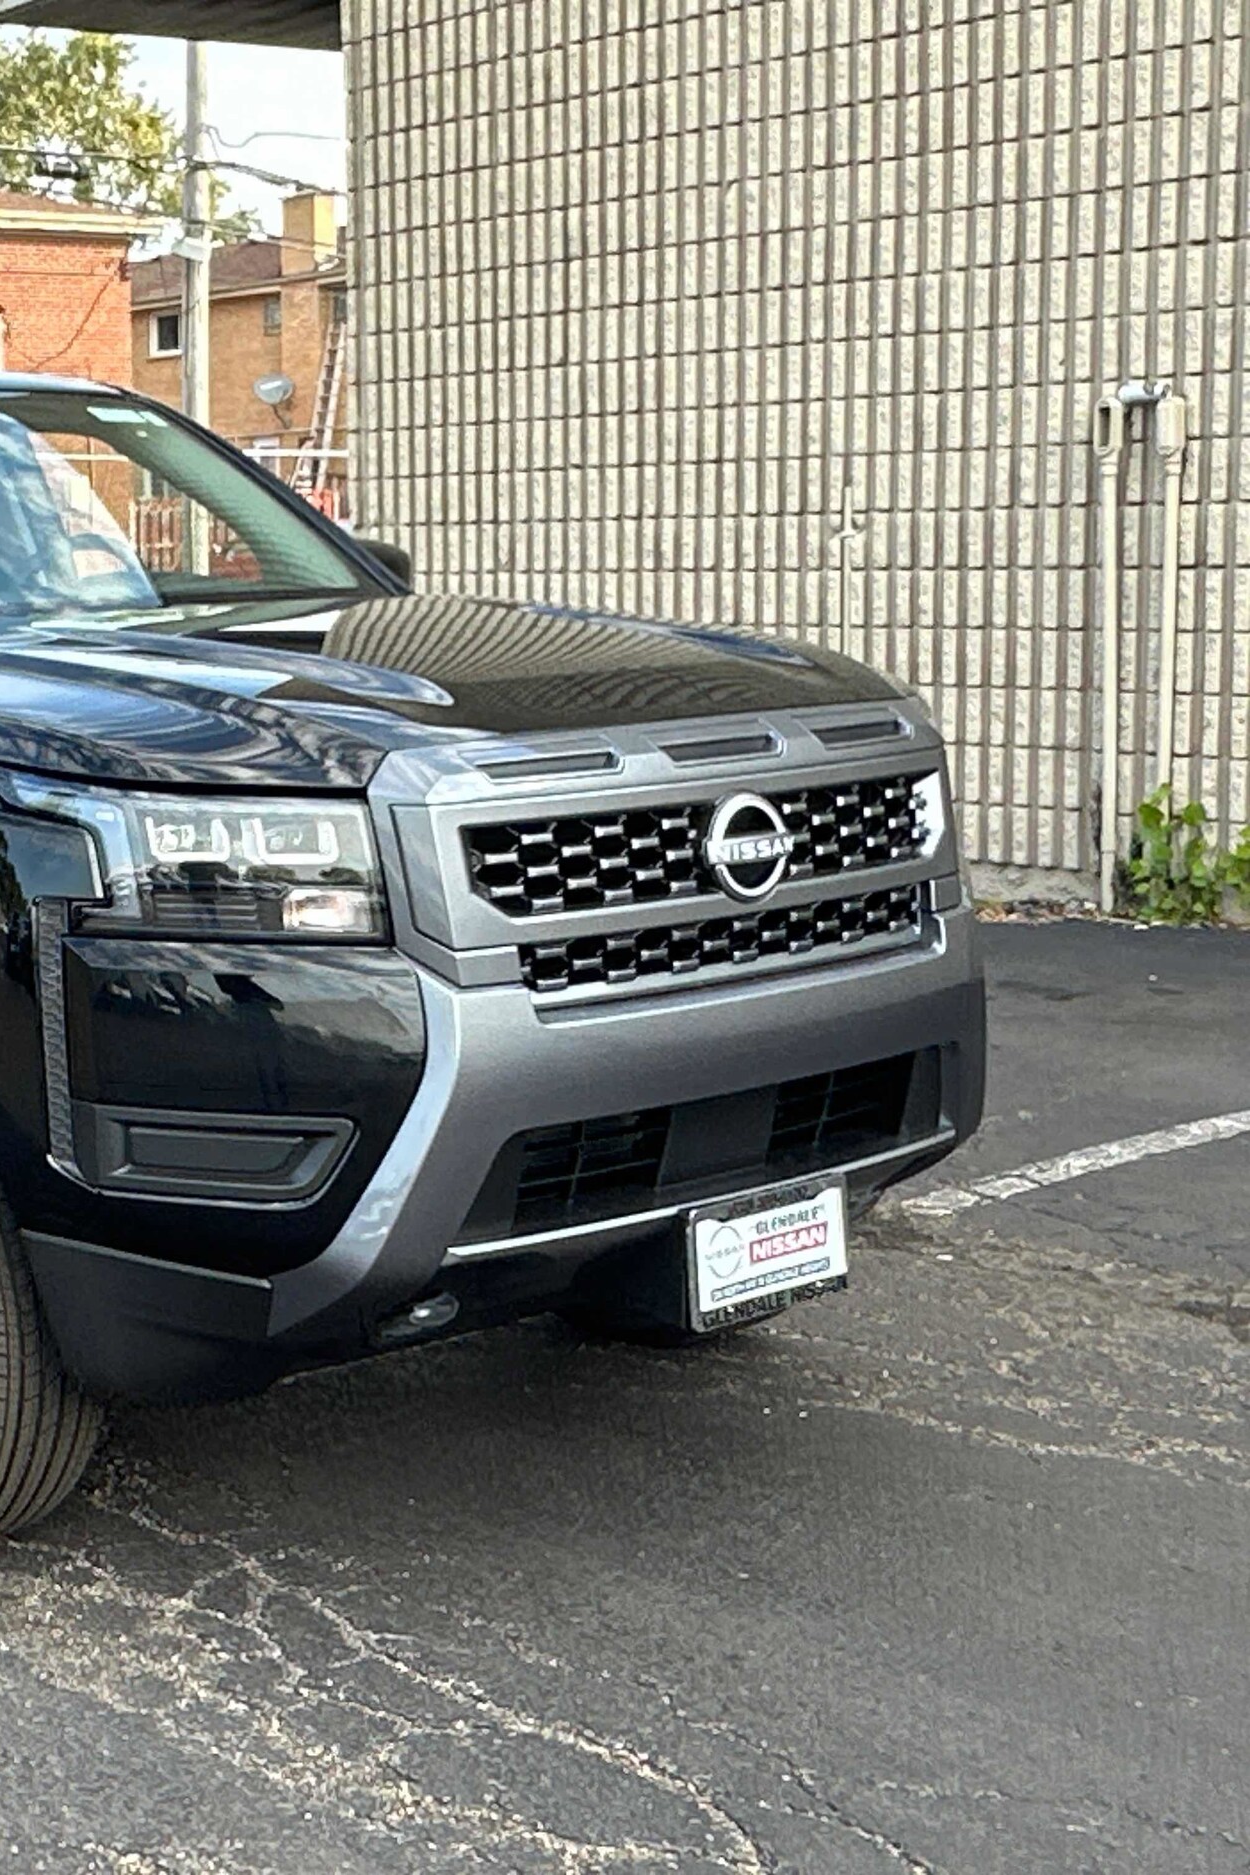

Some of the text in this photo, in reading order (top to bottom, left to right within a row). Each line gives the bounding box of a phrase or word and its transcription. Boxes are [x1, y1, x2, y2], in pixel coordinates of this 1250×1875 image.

[707, 835, 795, 864] NISSAN
[755, 1205, 820, 1235] GLENDALE
[751, 1223, 828, 1262] NISSAN
